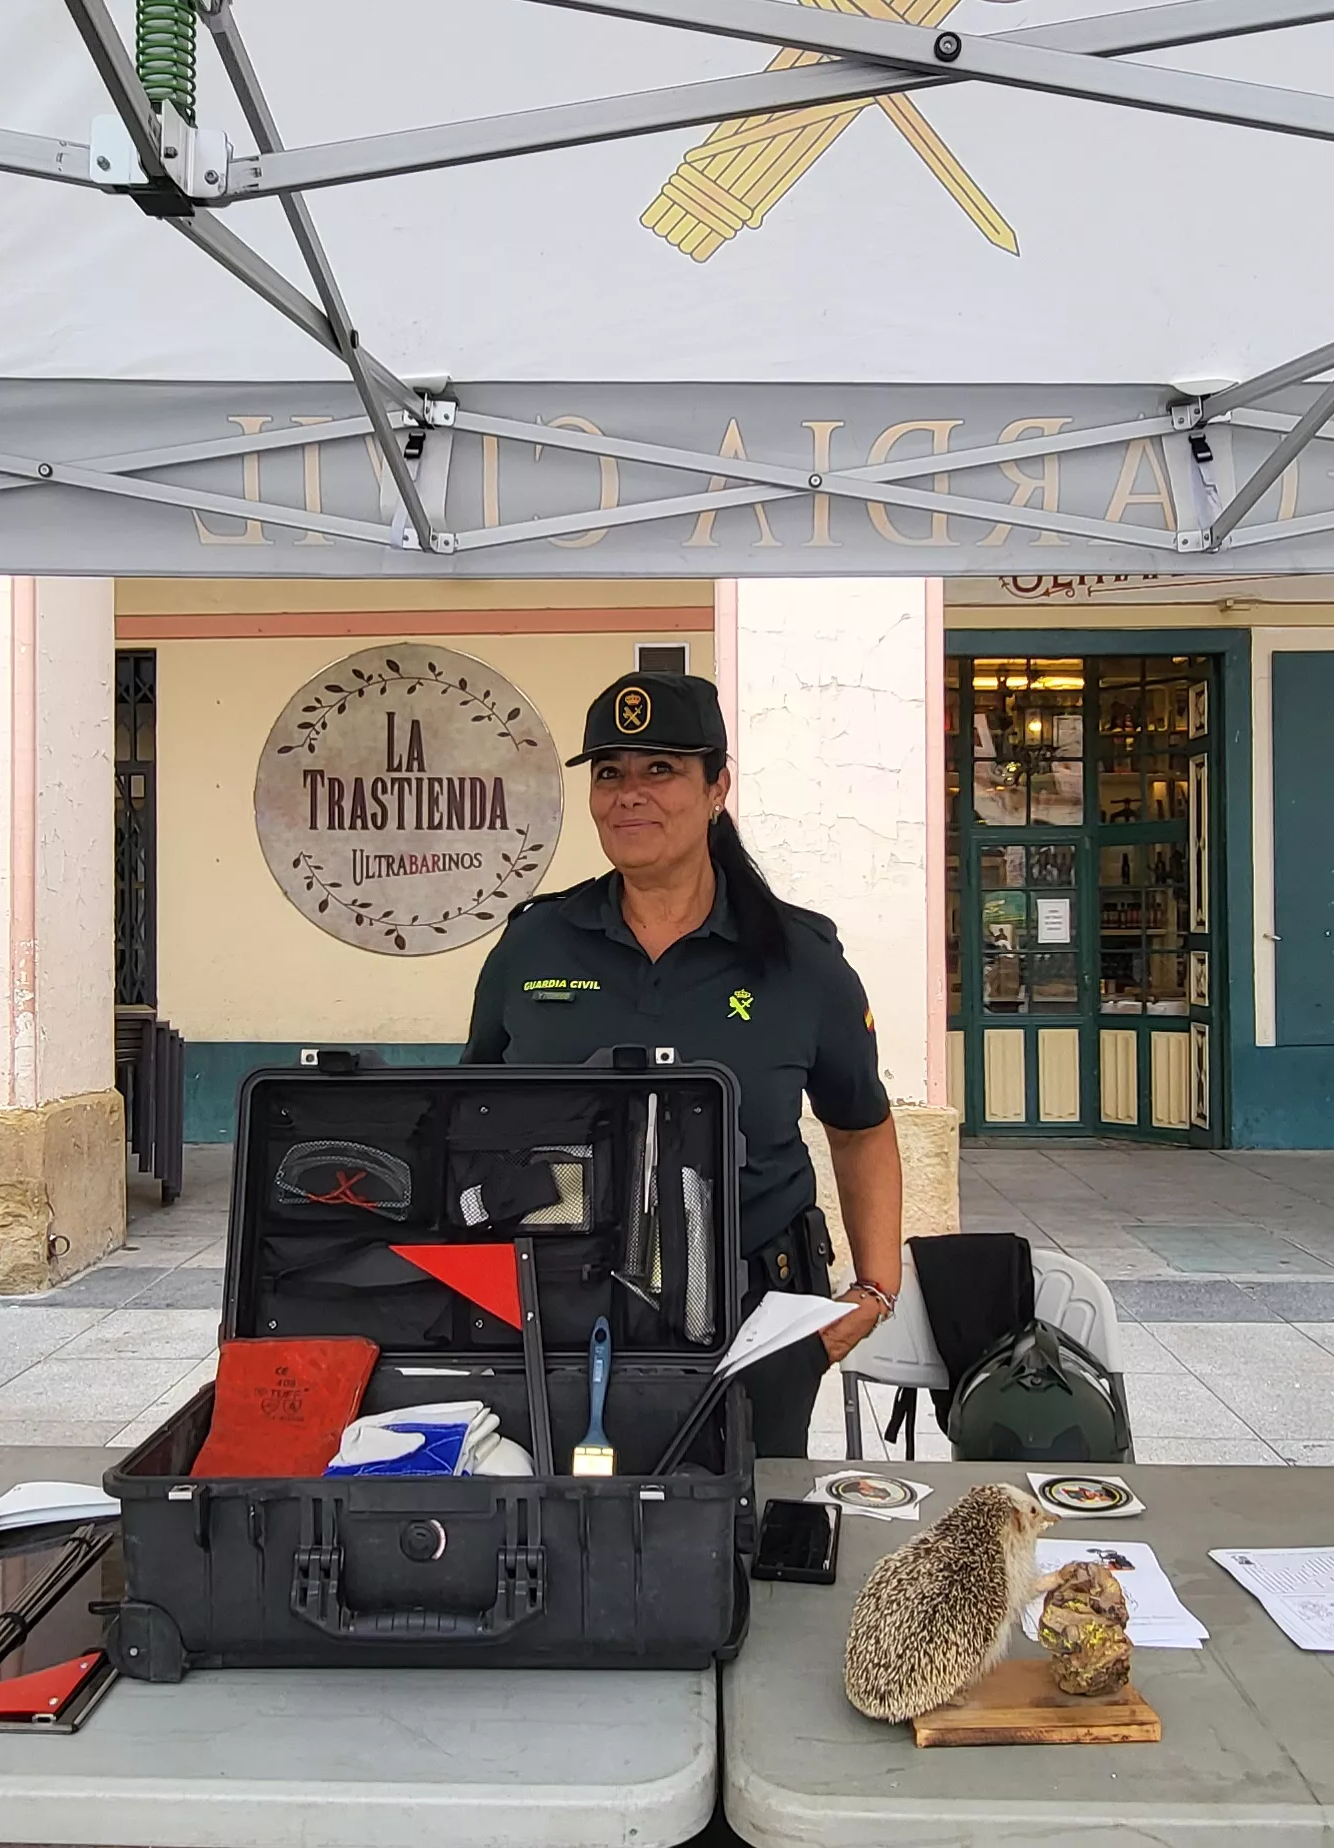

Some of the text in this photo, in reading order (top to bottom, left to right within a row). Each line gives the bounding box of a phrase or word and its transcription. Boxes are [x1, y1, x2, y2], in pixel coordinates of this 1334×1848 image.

[385, 711, 427, 772] LA
[302, 769, 510, 831] TRASTIENDA
[351, 848, 483, 886] ULTRABARINOS
[523, 980, 601, 992] GUARDIA CIVIL
